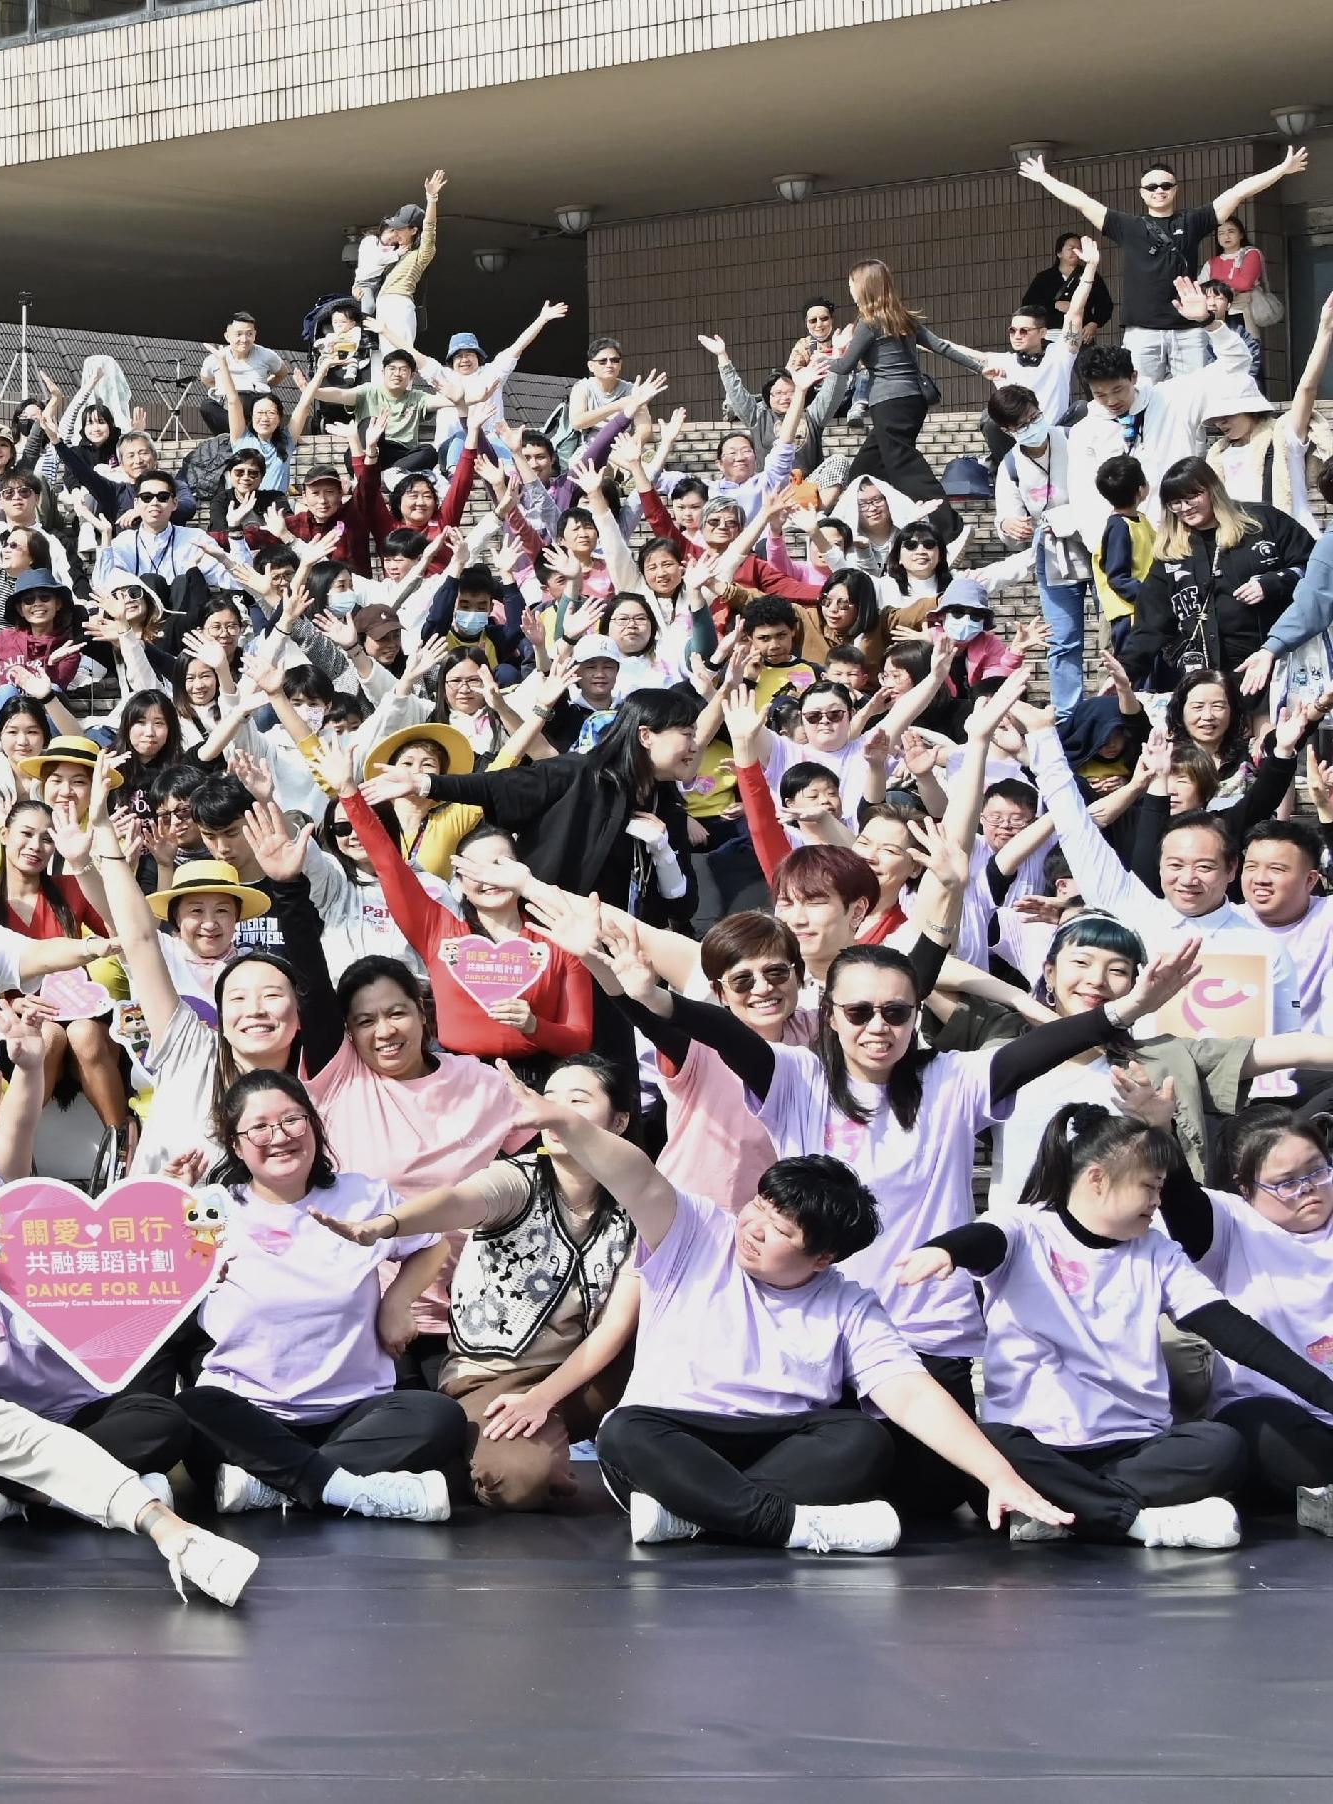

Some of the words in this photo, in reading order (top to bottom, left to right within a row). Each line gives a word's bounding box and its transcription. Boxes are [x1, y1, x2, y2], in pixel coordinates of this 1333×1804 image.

[1257, 1071, 1289, 1091] LL
[21, 1217, 85, 1248] 關愛
[108, 1215, 173, 1244] 同行
[25, 1248, 175, 1276] 共融舞蹈計劃
[25, 1282, 94, 1298] DANCE
[100, 1281, 140, 1296] FOR
[148, 1280, 182, 1295] ALL
[26, 1299, 70, 1309] Community
[71, 1299, 90, 1307] Care
[91, 1298, 125, 1307] Inclusive
[126, 1298, 150, 1306] Dance
[151, 1297, 182, 1306] Scheme
